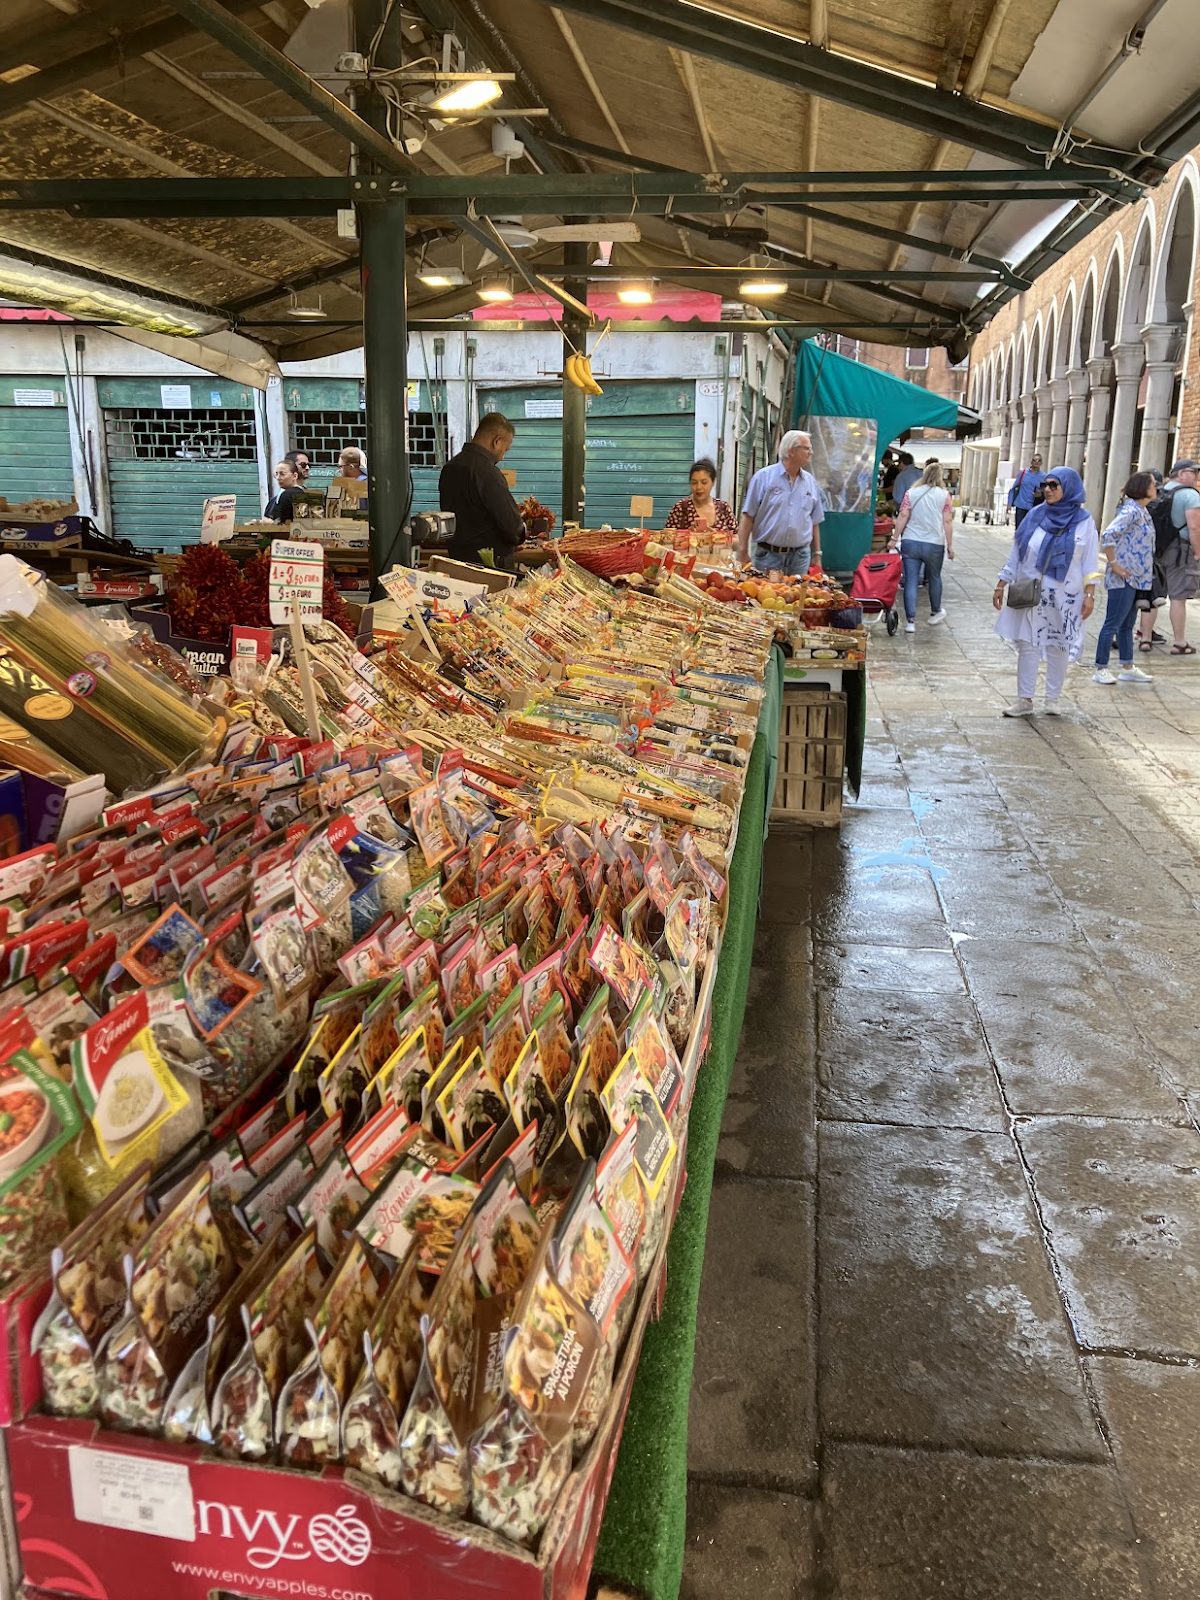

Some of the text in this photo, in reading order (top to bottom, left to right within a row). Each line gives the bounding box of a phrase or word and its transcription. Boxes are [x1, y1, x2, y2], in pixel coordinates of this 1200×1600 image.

[275, 542, 315, 558] SUPER OFFER
[296, 589, 312, 599] EURO
[423, 585, 450, 597] Melinda
[186, 650, 226, 666] mean
[92, 1010, 140, 1063] Zanier
[374, 1178, 418, 1235] Zanier
[542, 1328, 578, 1399] SPAGHETTATA
[556, 1341, 585, 1402] AI PORCINI
[196, 1498, 311, 1569] nvy
[171, 1560, 373, 1600] www.envyapples.com
